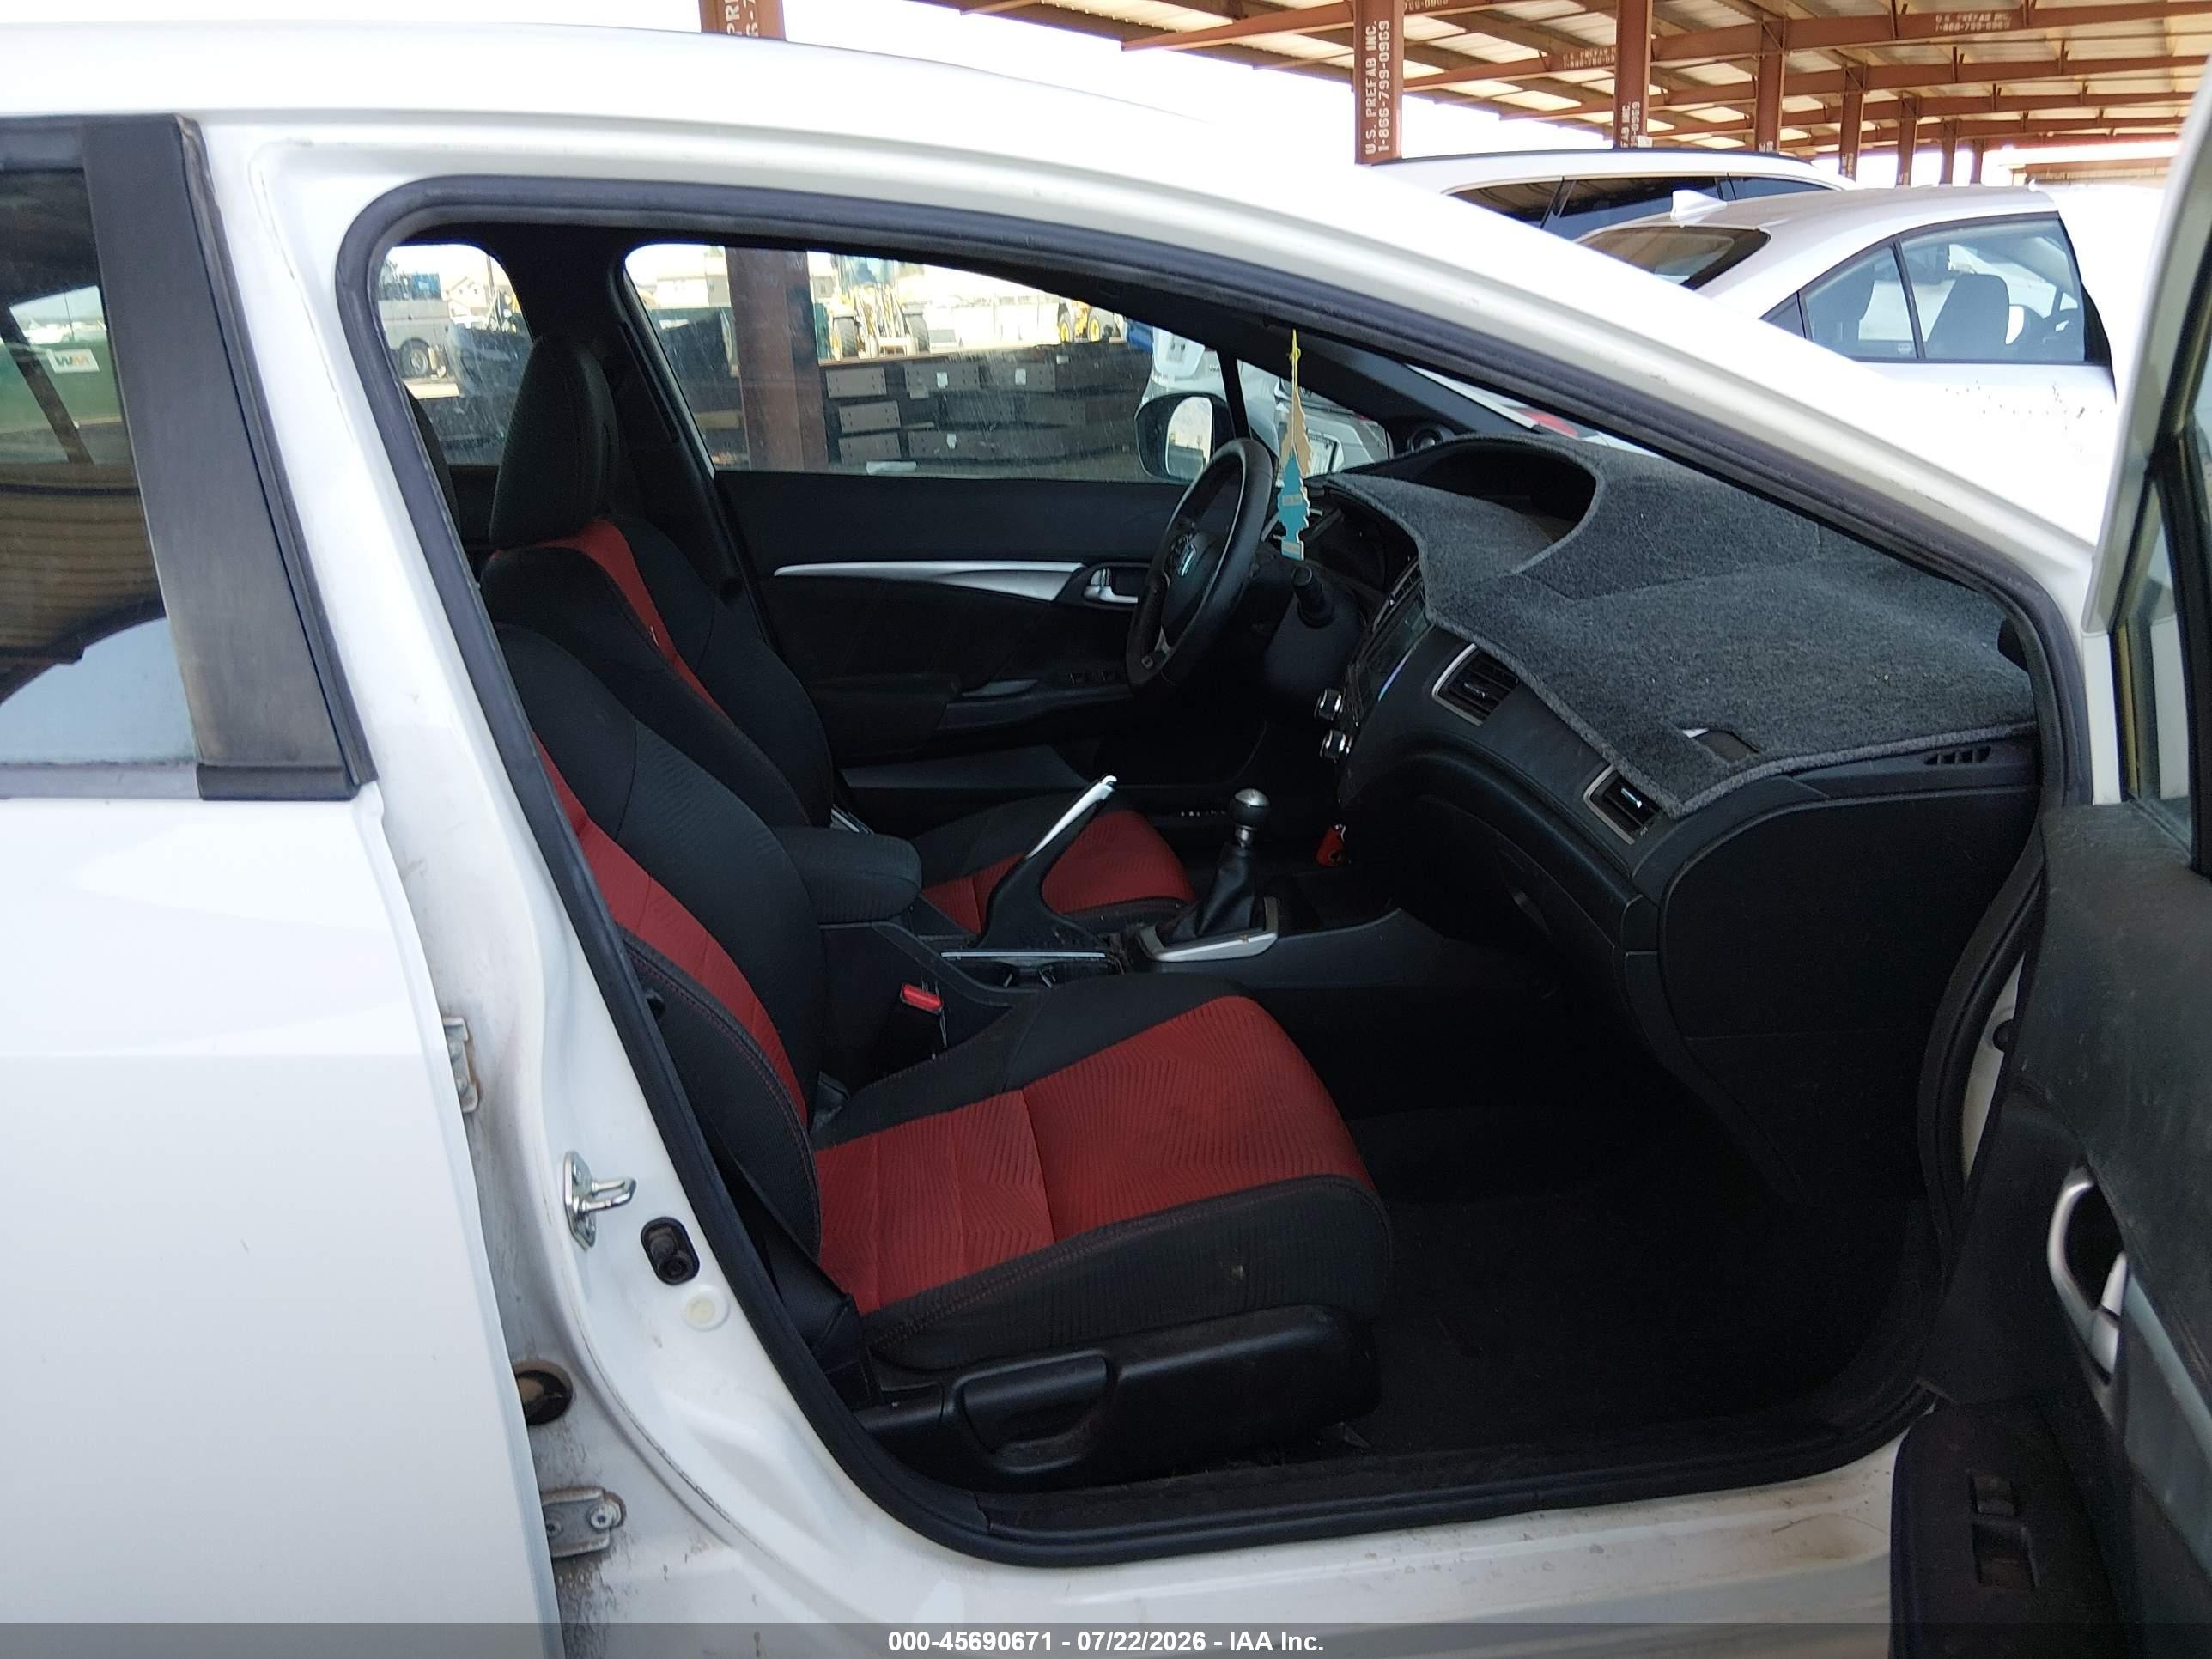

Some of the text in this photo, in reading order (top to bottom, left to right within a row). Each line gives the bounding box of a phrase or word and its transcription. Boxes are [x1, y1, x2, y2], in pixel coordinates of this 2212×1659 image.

[1365, 21, 1376, 155] U.S. PREFAB INC.
[1378, 20, 1389, 152] 1-866-799-0969
